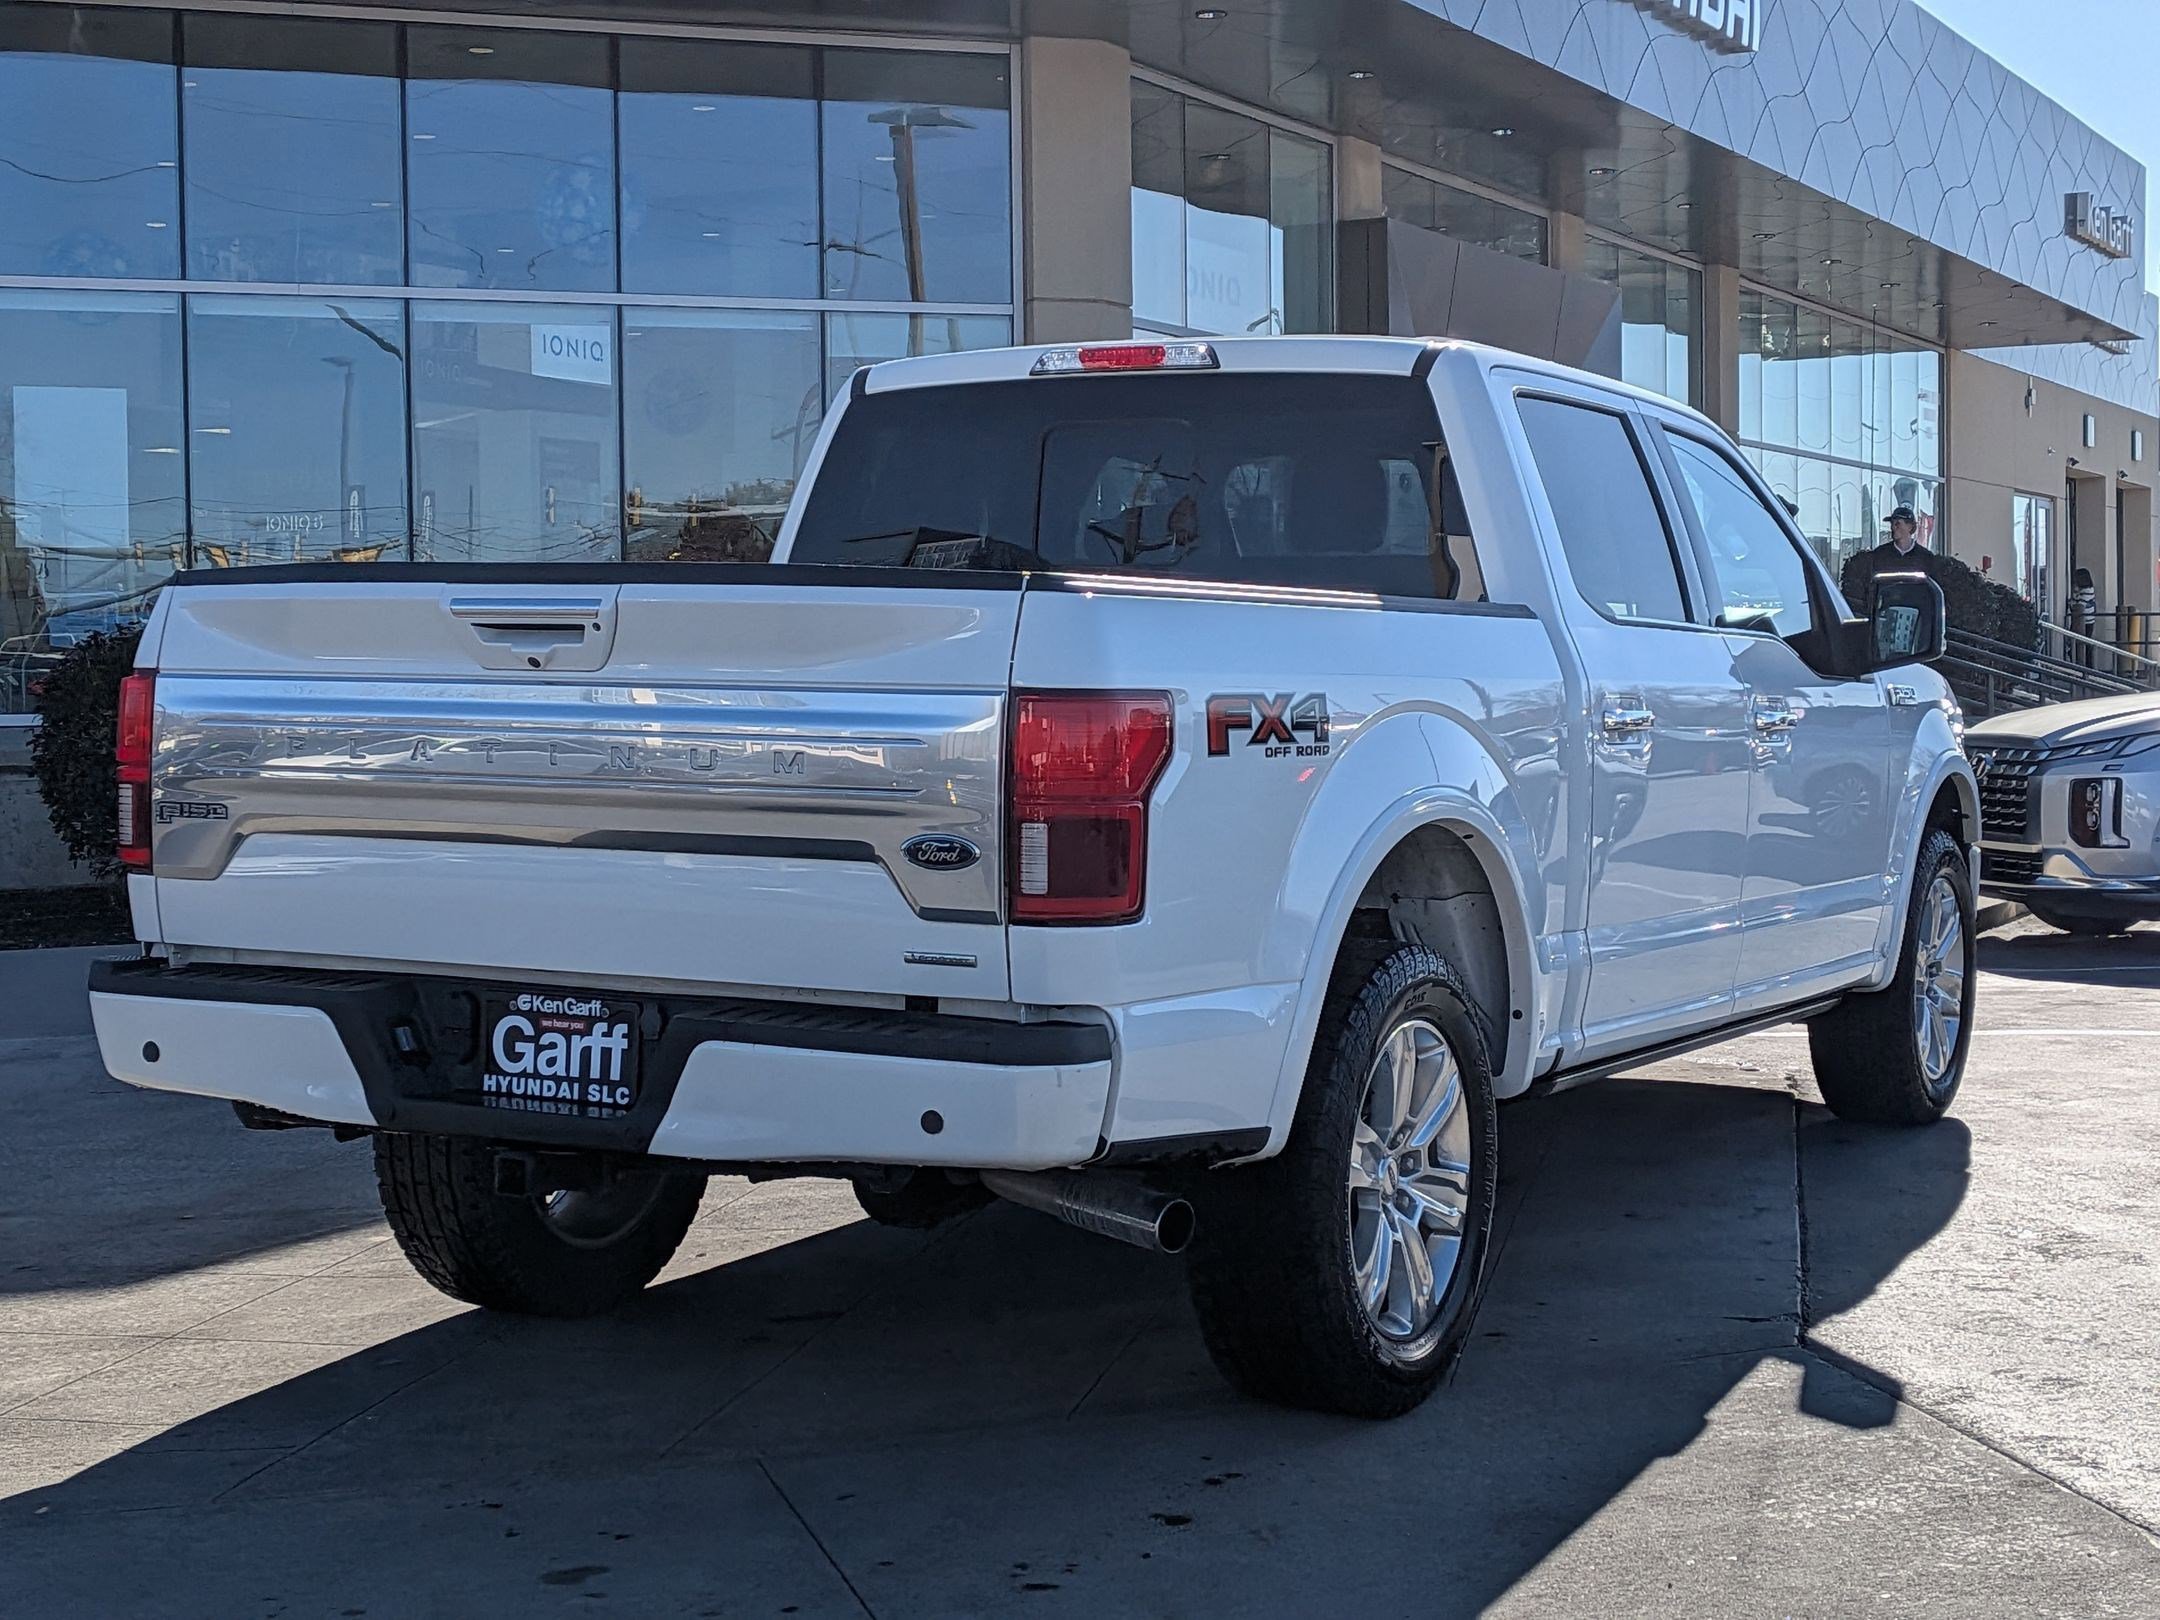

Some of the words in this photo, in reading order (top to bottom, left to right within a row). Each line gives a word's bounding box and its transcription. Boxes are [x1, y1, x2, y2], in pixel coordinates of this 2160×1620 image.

[542, 333, 604, 362] IONIQ
[1205, 692, 1330, 757] FX4
[285, 736, 806, 775] PLATINUM
[1265, 747, 1291, 758] OFF
[1296, 745, 1330, 757] ROAD
[917, 841, 961, 863] Ford
[492, 1015, 628, 1081] Garff
[483, 1074, 579, 1100] HYUNDAI
[587, 1083, 630, 1105] SLC
